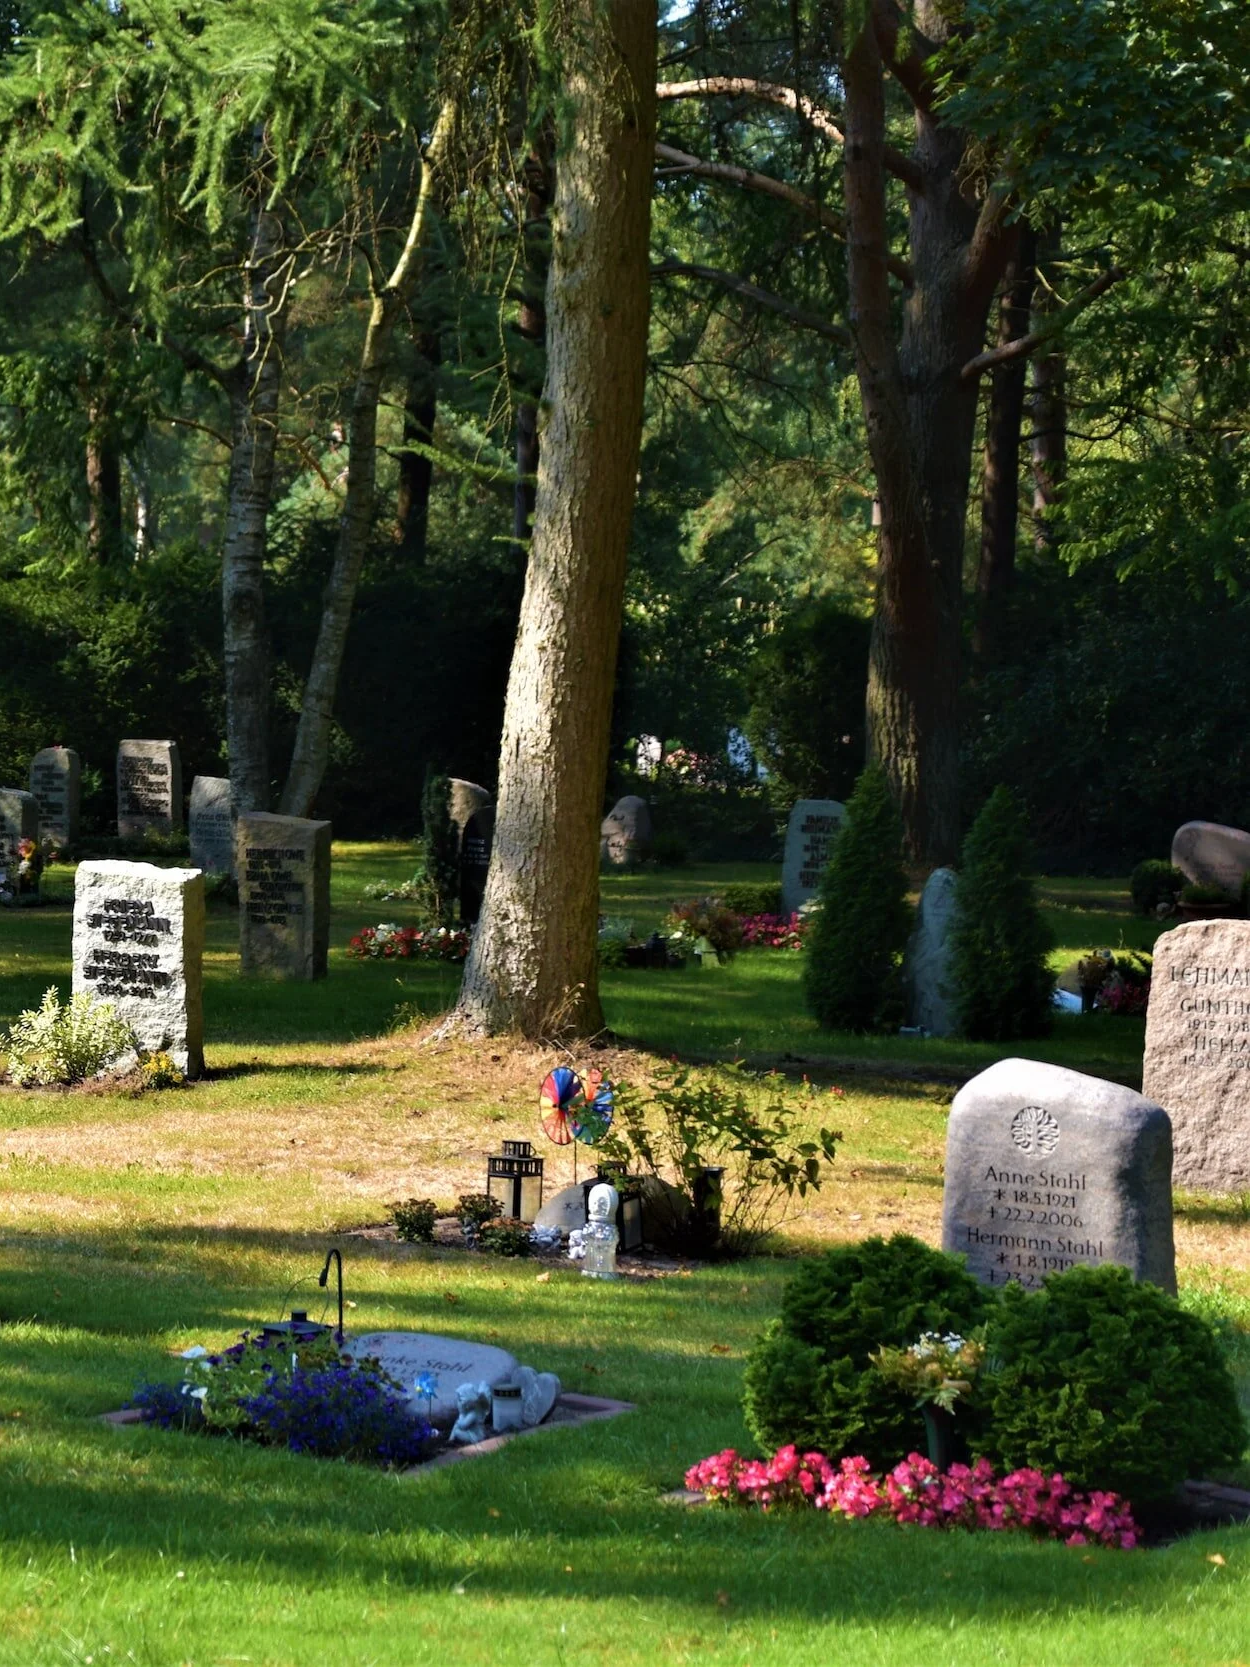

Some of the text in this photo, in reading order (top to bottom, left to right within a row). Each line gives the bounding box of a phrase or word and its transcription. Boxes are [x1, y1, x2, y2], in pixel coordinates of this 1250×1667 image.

[984, 1165, 1086, 1191] Anne Stahl
[1013, 1190, 1077, 1209] 18.5.1921
[1004, 1207, 1083, 1229] 22.2.2006
[967, 1226, 1104, 1257] Hermann Stahl
[421, 1358, 474, 1374] Stahl
